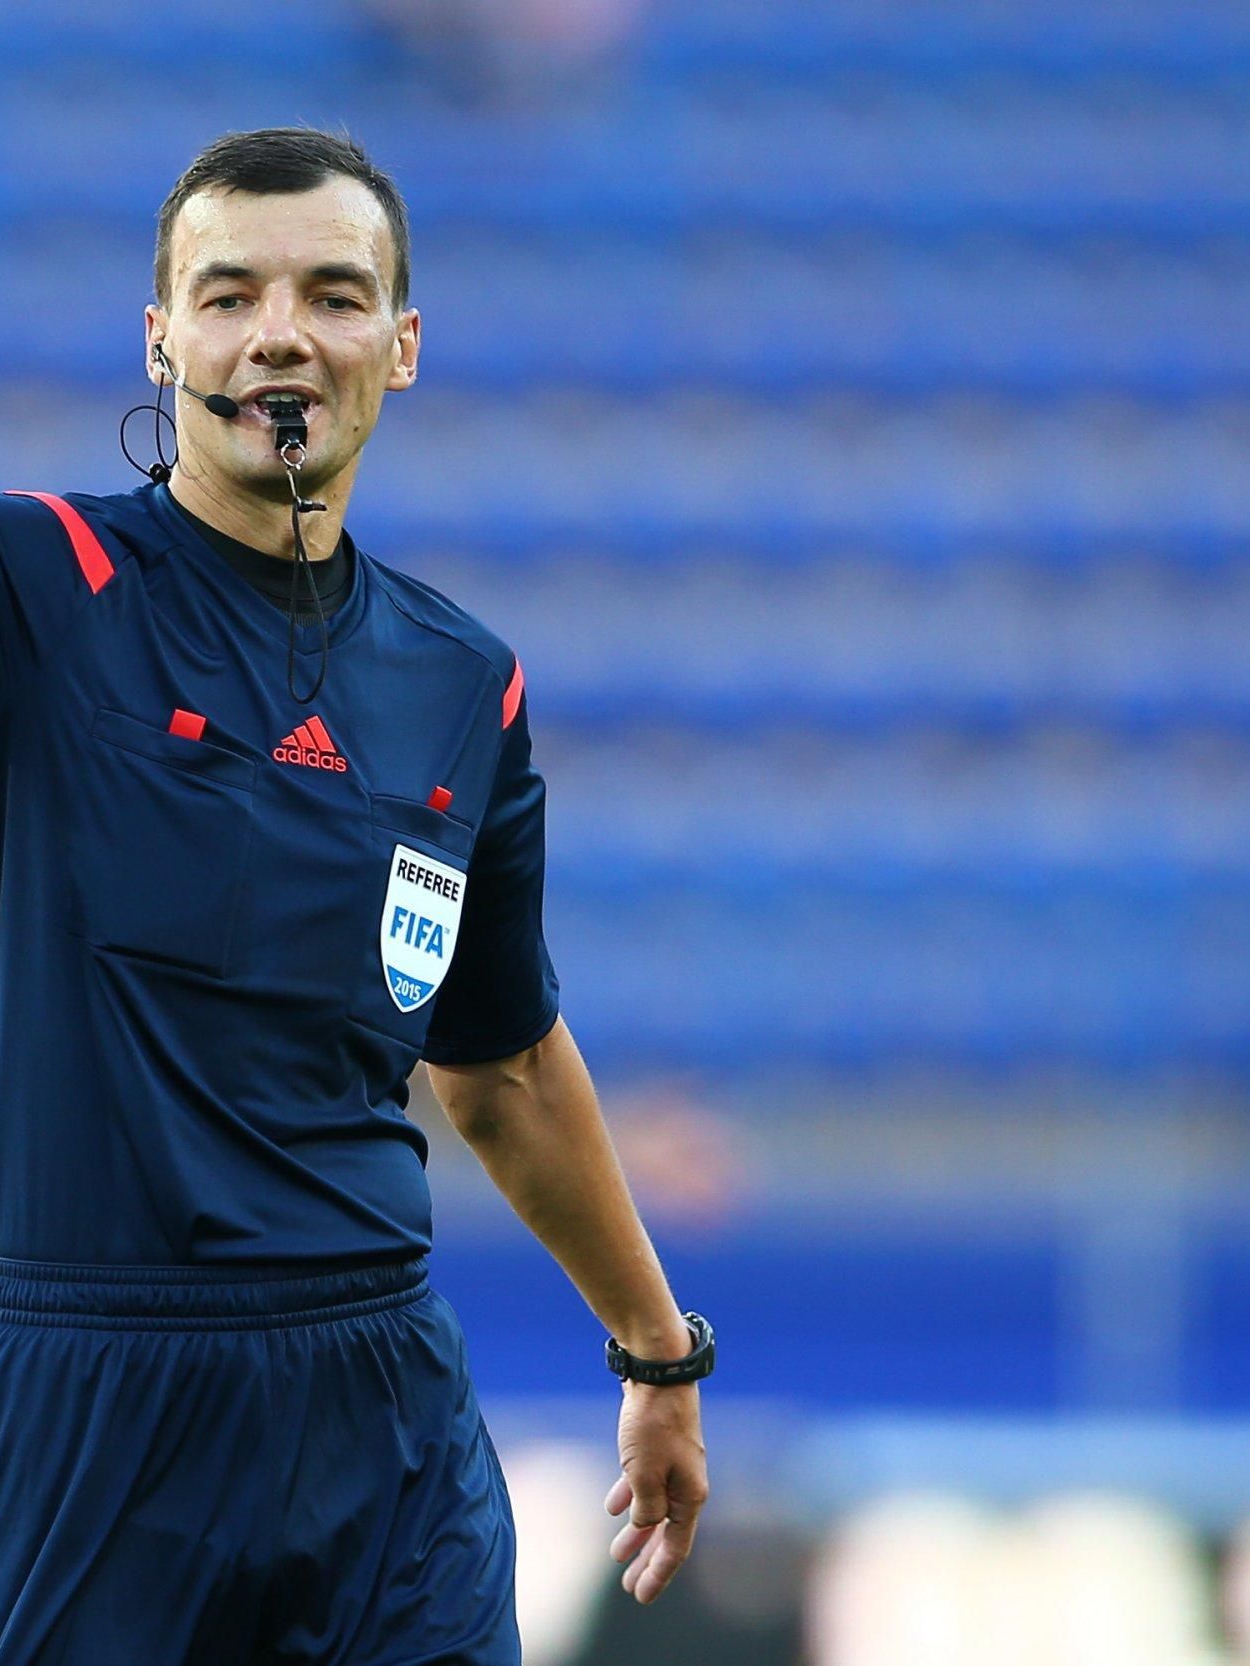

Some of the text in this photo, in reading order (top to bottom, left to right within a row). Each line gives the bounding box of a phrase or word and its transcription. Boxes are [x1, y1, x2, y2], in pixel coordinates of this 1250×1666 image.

[273, 746, 347, 772] adidas
[396, 858, 460, 902] REFEREE
[394, 977, 422, 1002] 2015
